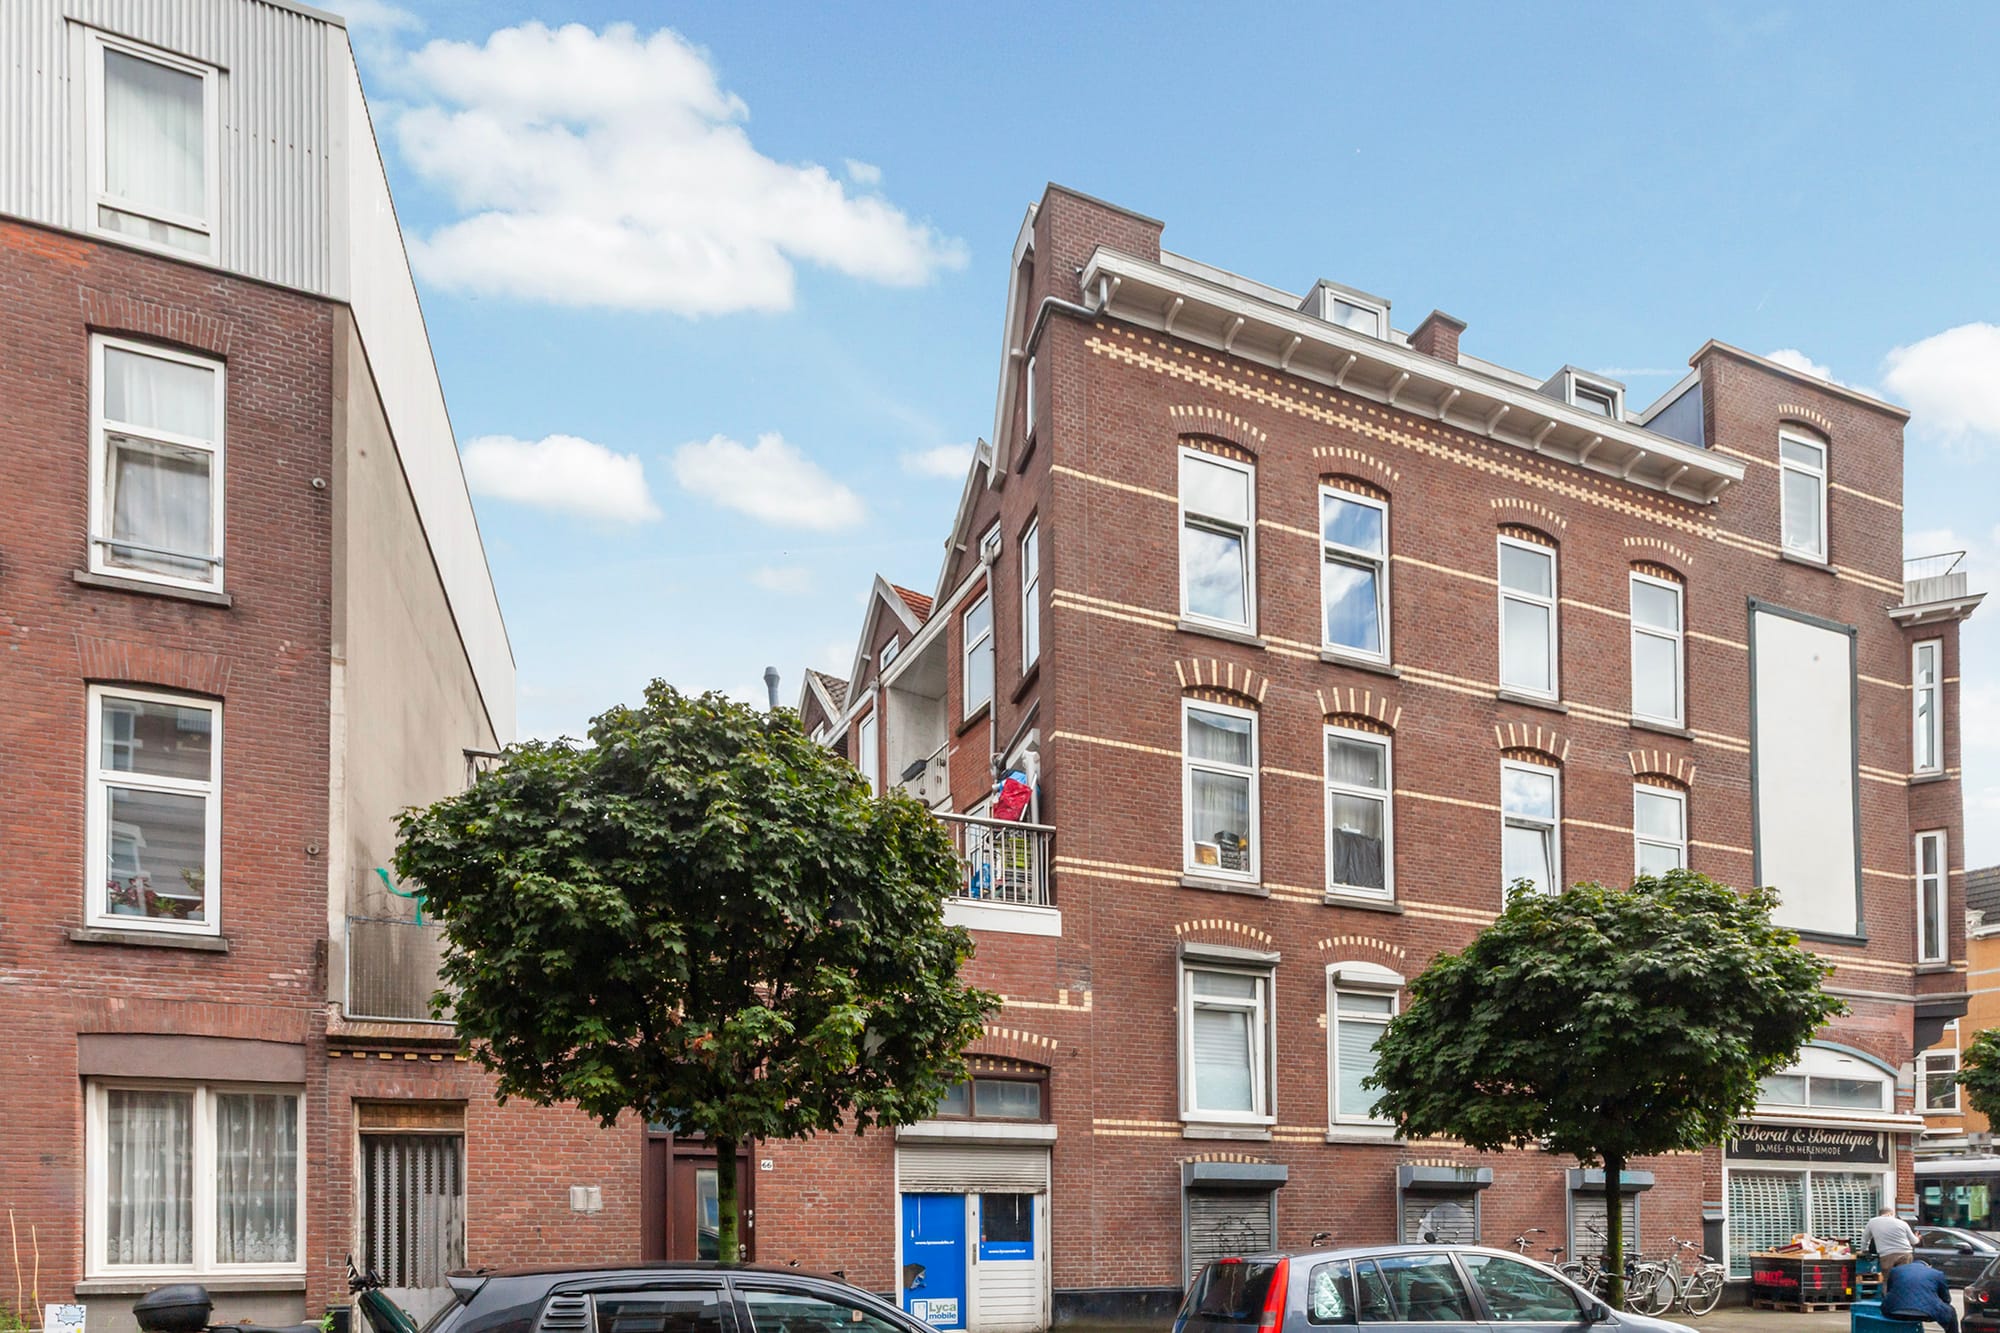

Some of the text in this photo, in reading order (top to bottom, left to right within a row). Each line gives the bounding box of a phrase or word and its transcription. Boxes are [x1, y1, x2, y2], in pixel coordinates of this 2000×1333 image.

[1742, 1125, 1874, 1152] Berat & Boutique
[1785, 1144, 1795, 1153] EN
[1798, 1145, 1841, 1156] HERENMODE
[929, 1302, 956, 1314] Lyca
[929, 1312, 957, 1320] mobile
